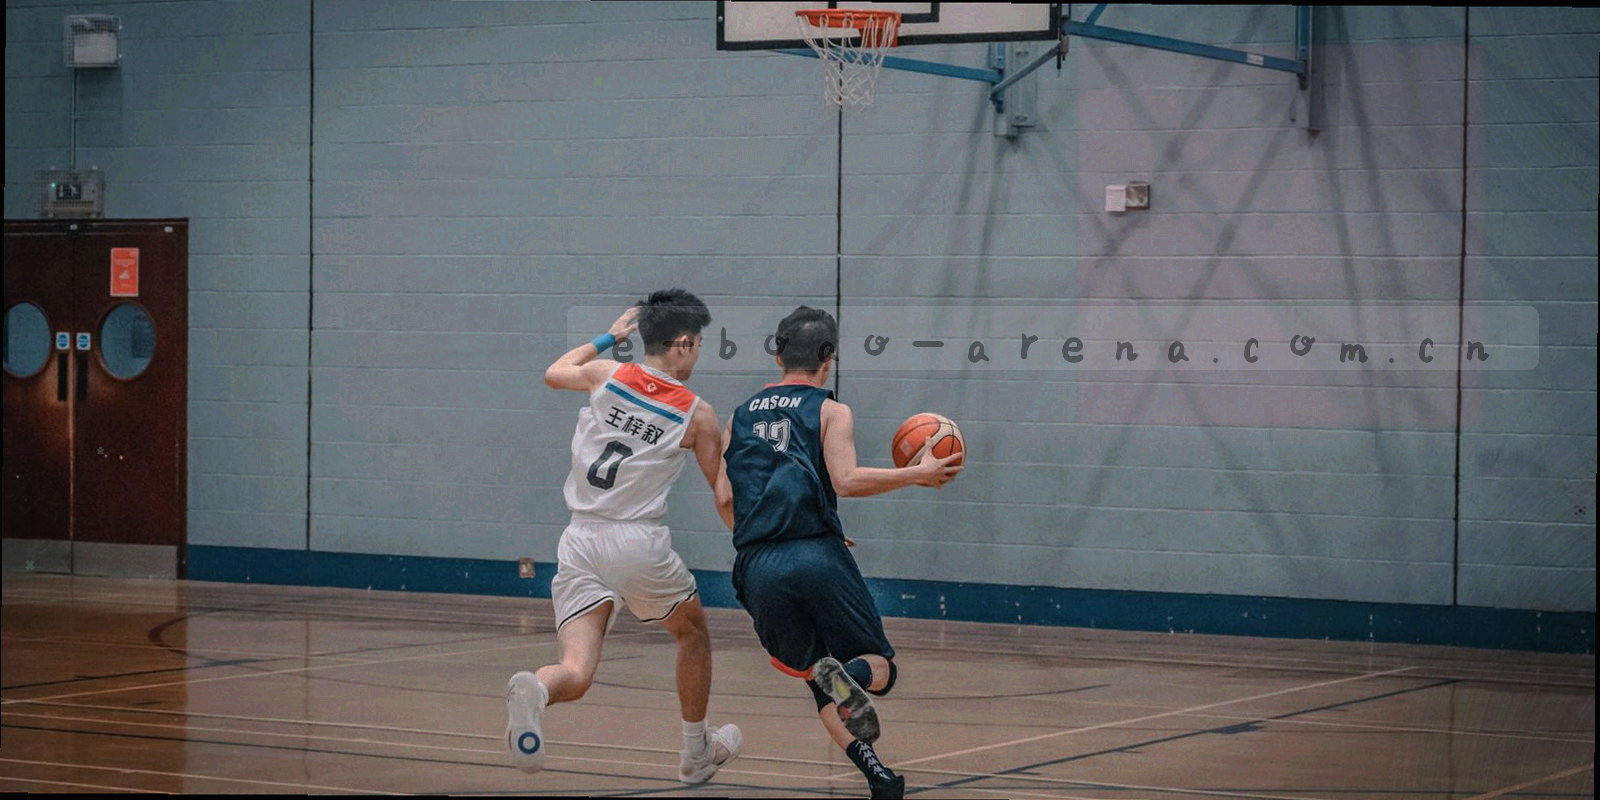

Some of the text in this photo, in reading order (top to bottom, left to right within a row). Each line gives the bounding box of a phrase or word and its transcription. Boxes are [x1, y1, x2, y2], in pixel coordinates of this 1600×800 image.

[749, 395, 802, 412] CASON
[604, 406, 665, 445] 王梓叙
[586, 440, 634, 490] 0
